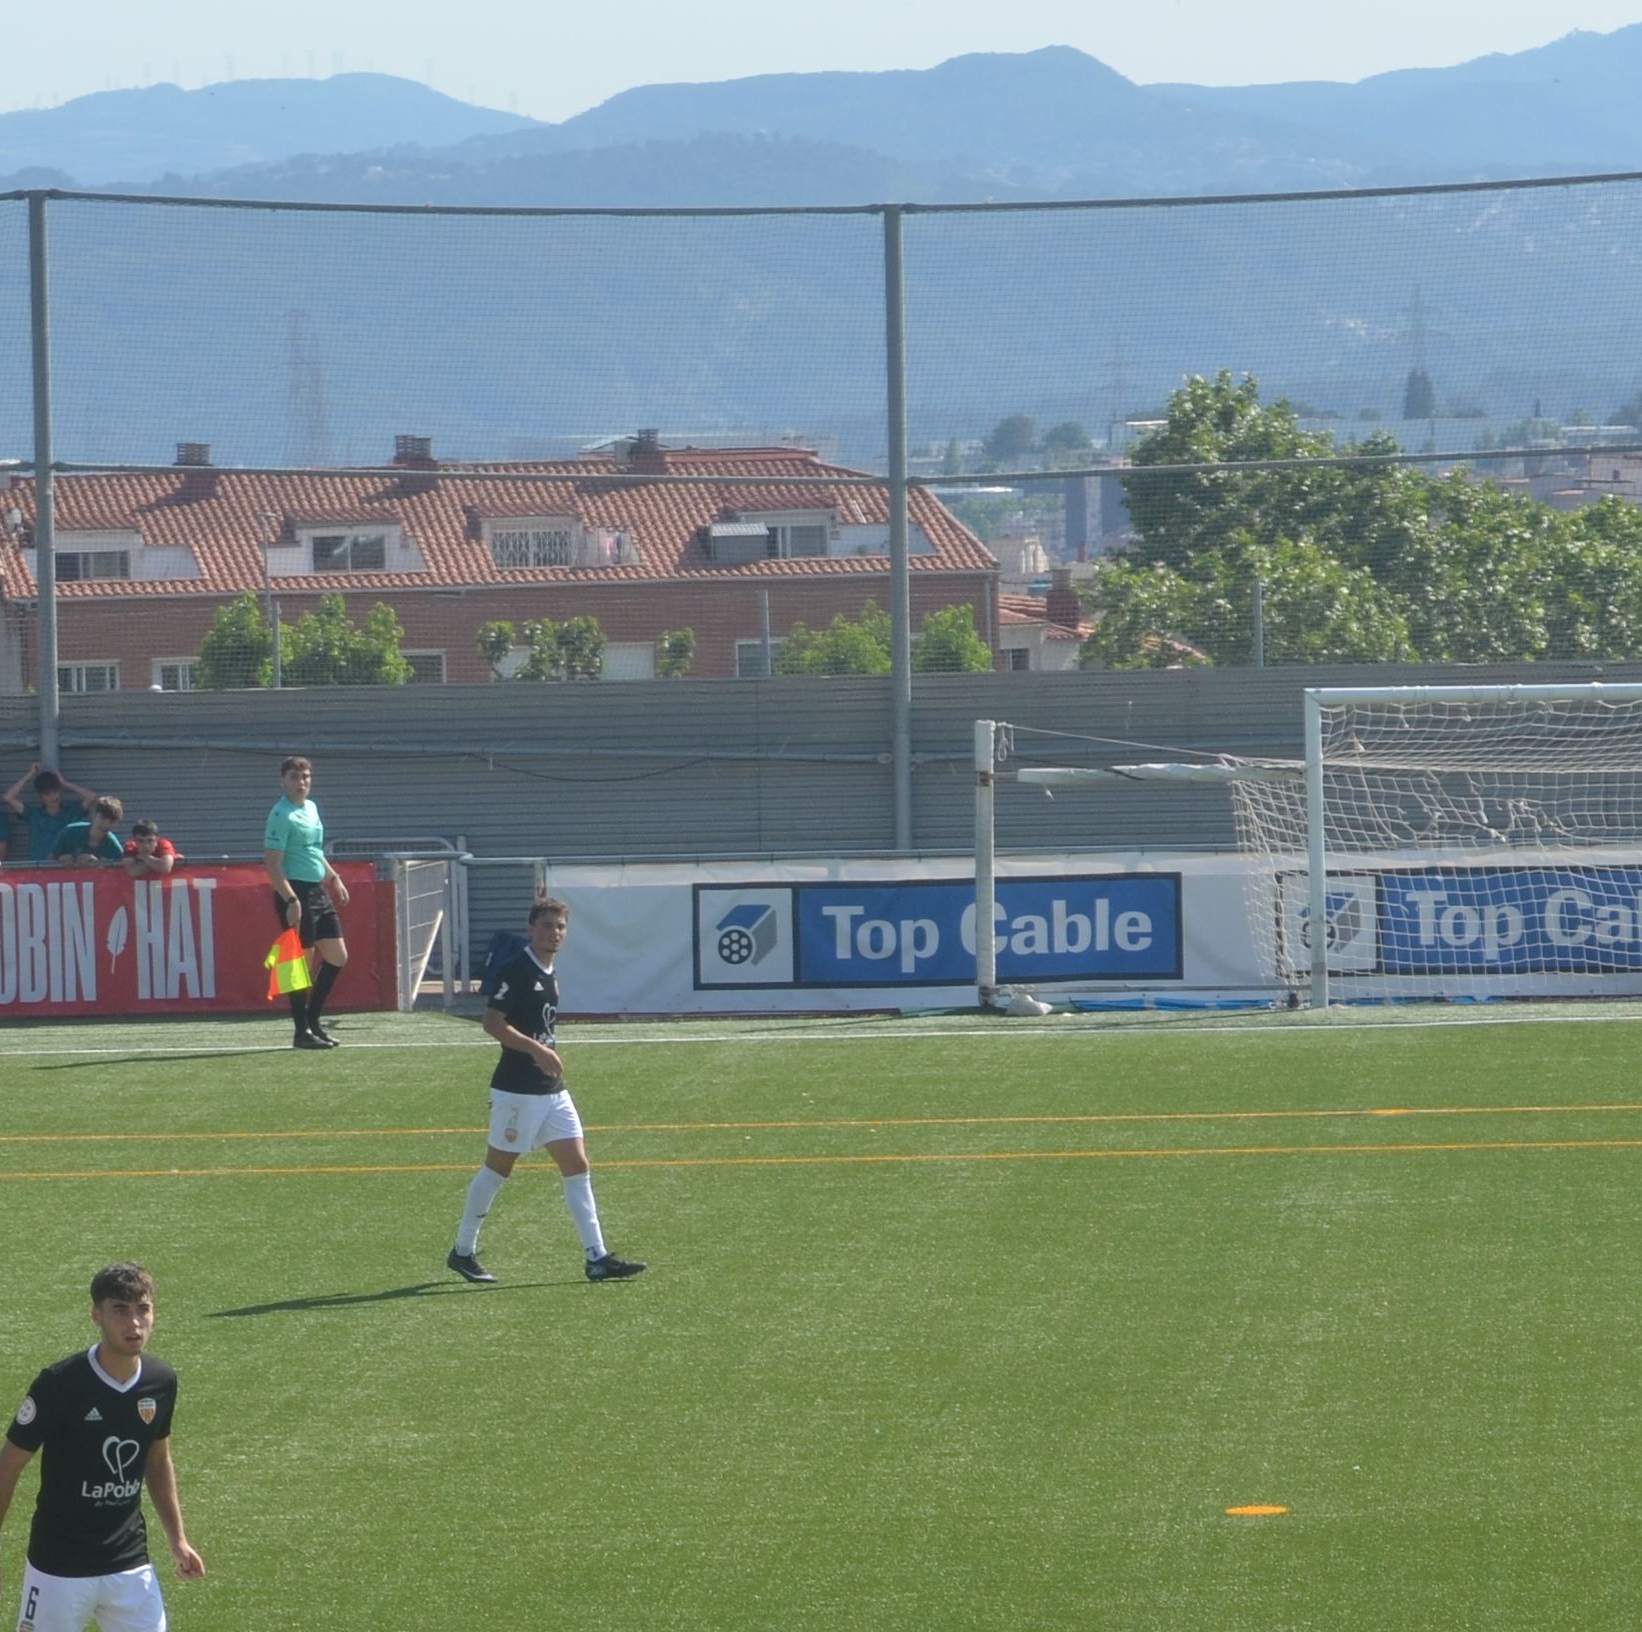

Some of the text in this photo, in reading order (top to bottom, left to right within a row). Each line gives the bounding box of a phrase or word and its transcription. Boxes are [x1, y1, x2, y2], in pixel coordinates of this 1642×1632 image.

[134, 878, 217, 999] HAT
[822, 897, 1152, 973] Top Cable
[1407, 891, 1522, 960] Top
[24, 1585, 40, 1621] 6
